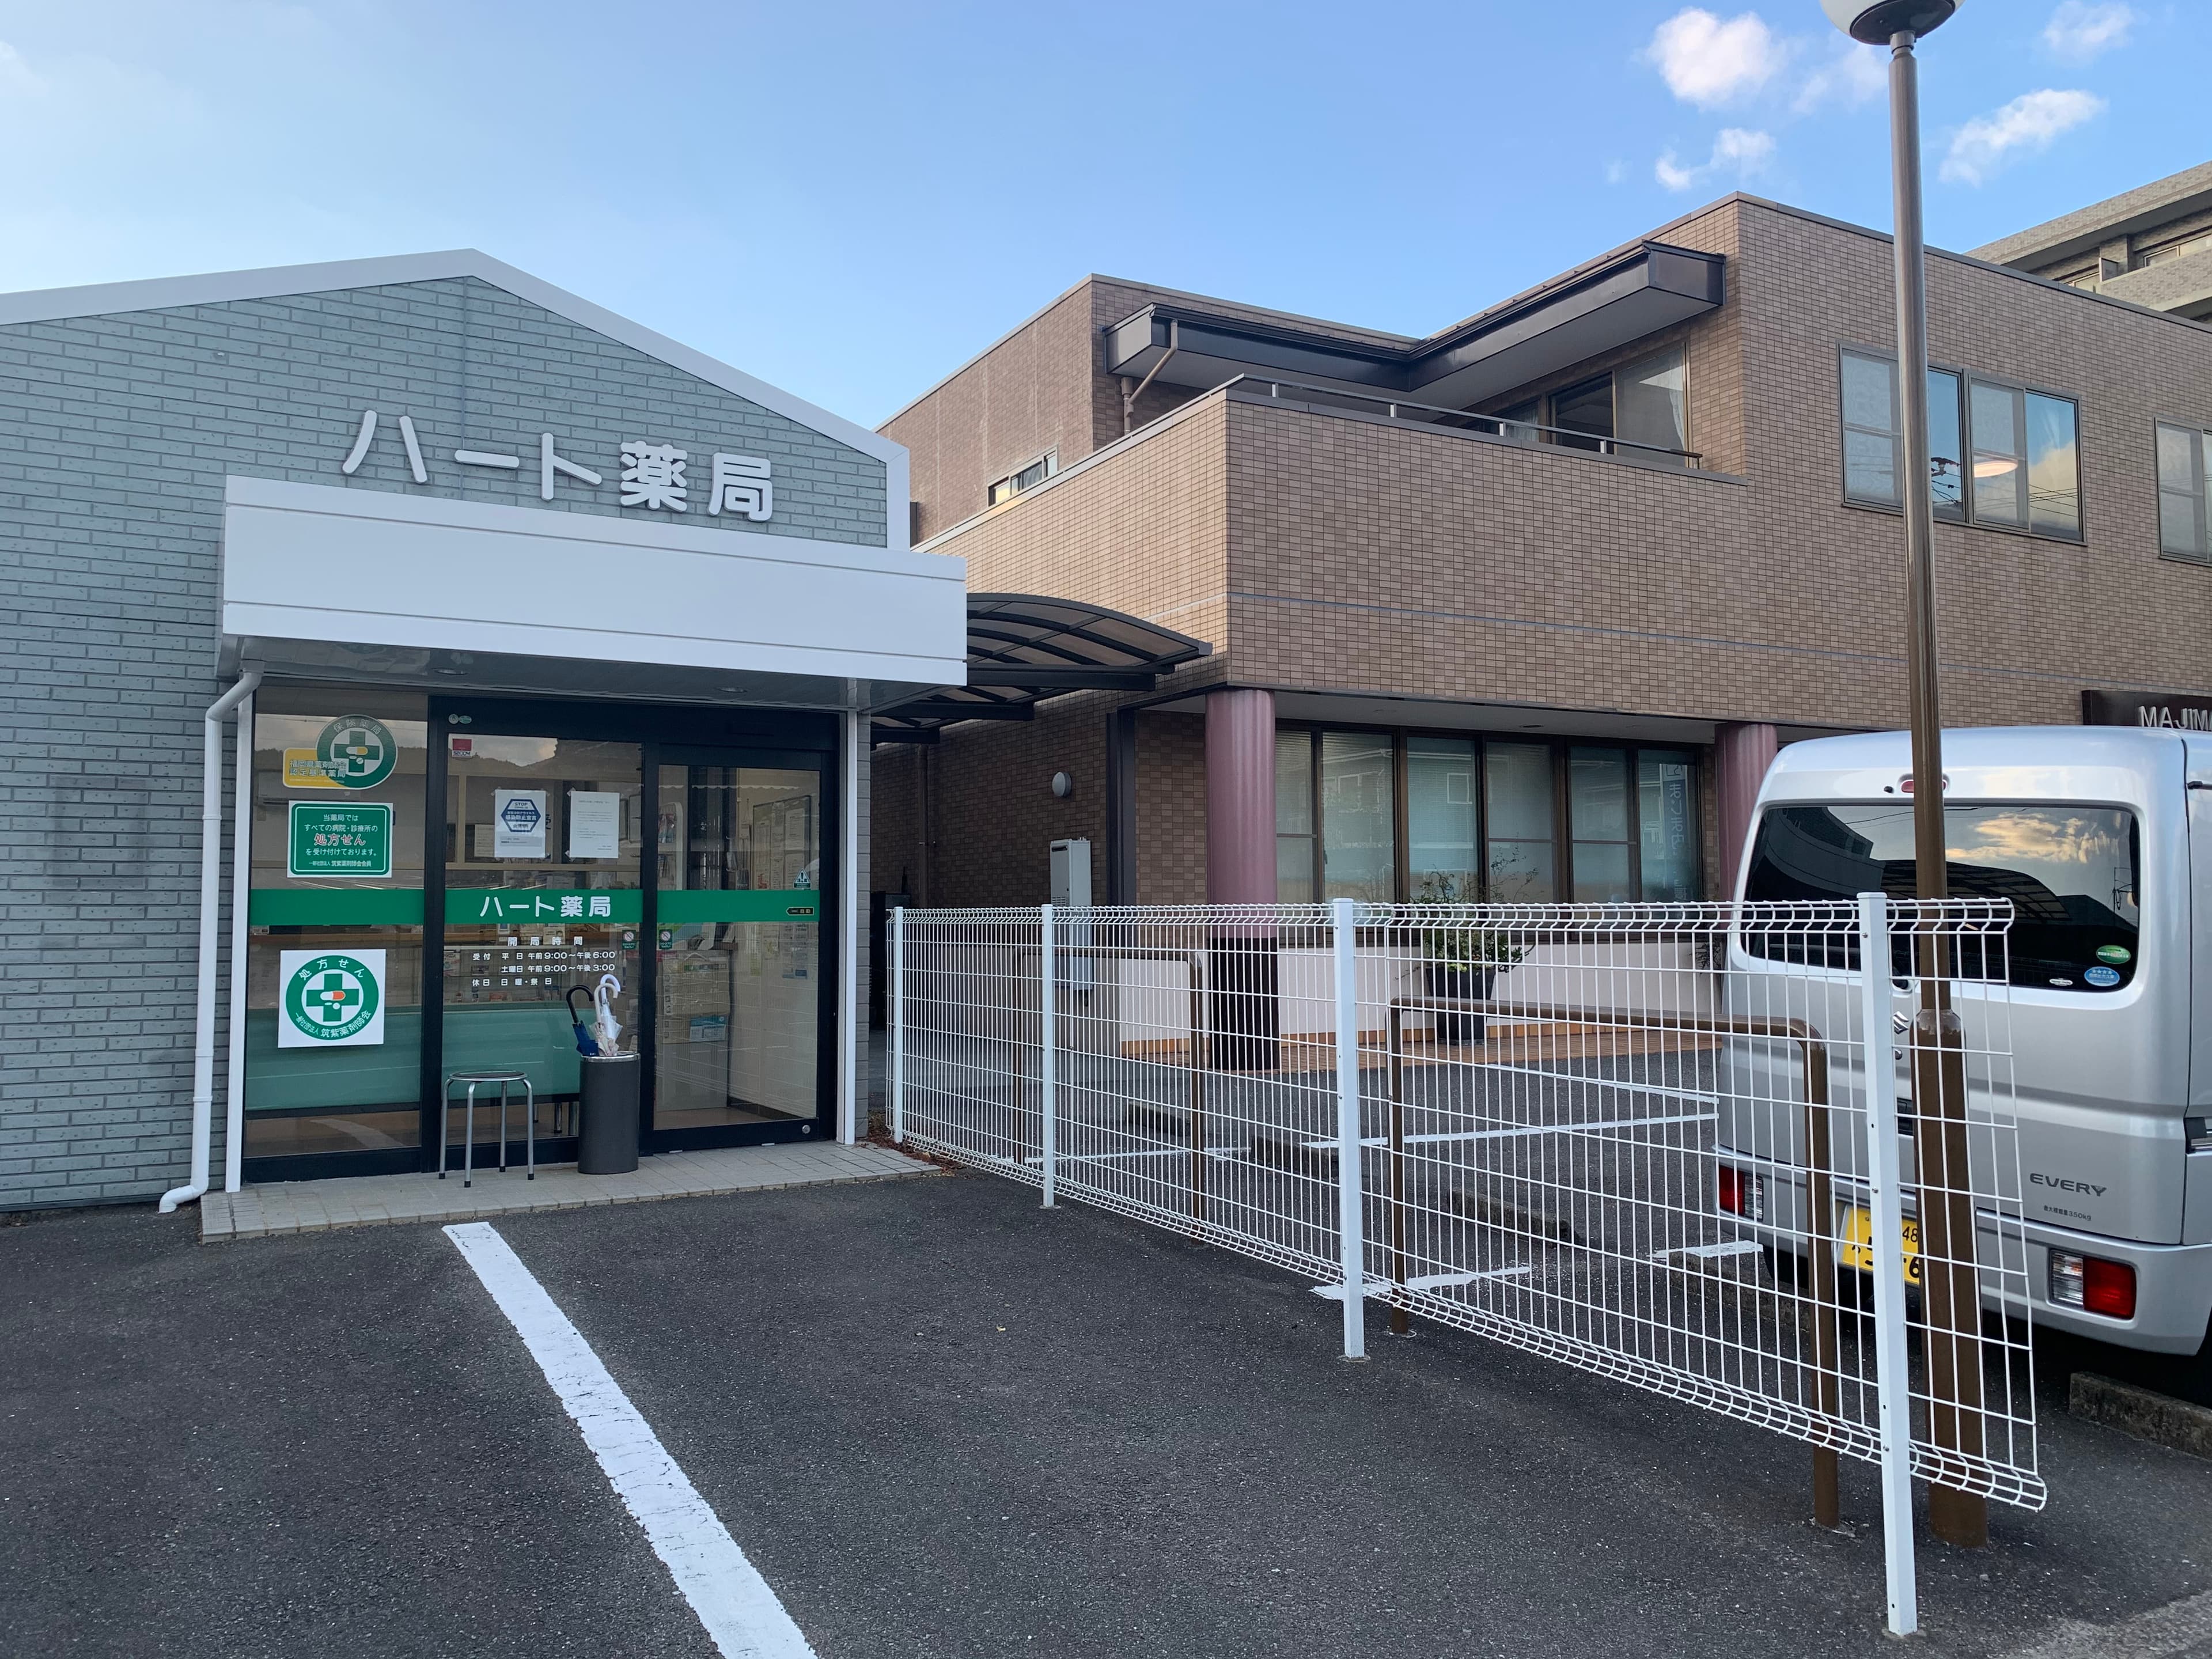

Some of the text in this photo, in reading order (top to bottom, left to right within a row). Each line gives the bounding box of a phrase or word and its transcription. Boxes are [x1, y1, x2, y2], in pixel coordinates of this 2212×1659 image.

[342, 409, 774, 522] ハート薬局
[334, 718, 382, 735] 保険薬局
[2138, 705, 2212, 732] MAJIM
[314, 834, 366, 846] 処方せん
[305, 848, 377, 856] を受け付けております。
[480, 896, 611, 917] ハート薬局
[507, 936, 583, 946] 開局時間
[472, 953, 491, 961] 受付
[501, 952, 523, 960] 平日
[298, 959, 365, 980] 処方せん
[501, 965, 523, 973] 土曜日
[472, 979, 490, 987] 休日
[320, 1010, 372, 1037] 筑紫薬剤師会
[2029, 1173, 2107, 1197] EVERY
